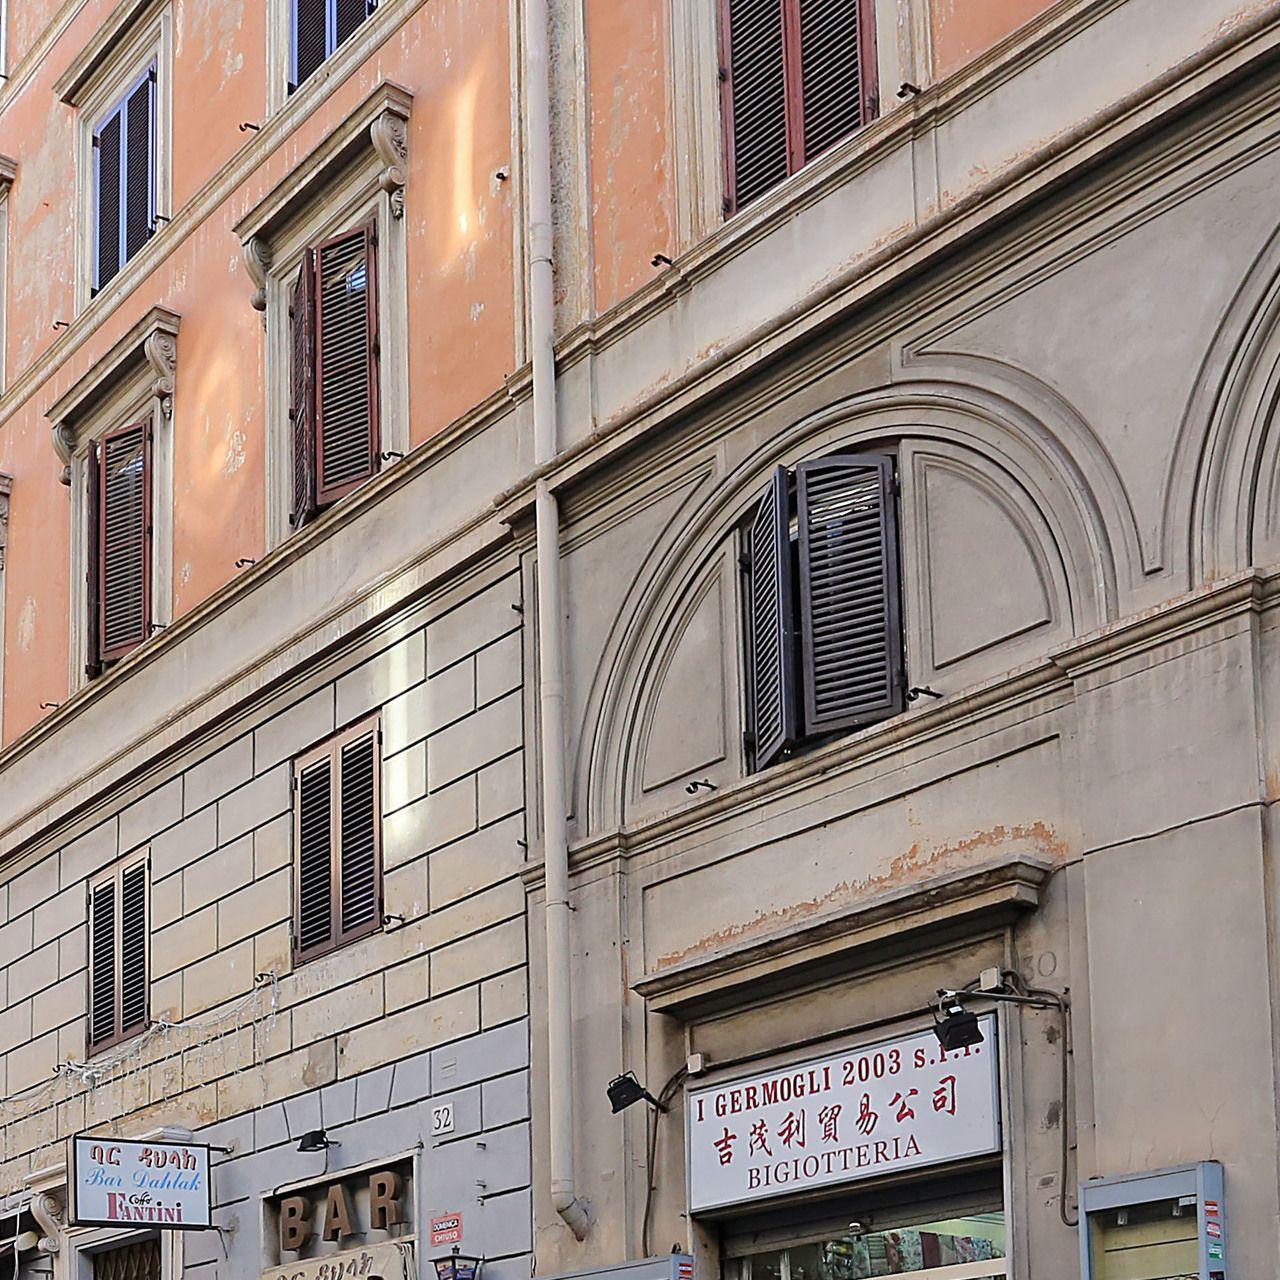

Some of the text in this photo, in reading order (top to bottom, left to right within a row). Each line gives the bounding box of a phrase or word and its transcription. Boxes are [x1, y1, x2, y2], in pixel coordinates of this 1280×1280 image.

[696, 1098, 705, 1122] I
[715, 1066, 831, 1118] GERMOGLI
[842, 1049, 901, 1087] 2003
[433, 1107, 451, 1130] 32
[84, 1167, 201, 1191] Bar Dahlak
[747, 1133, 923, 1190] BIGIOTTERIA
[281, 1171, 405, 1251] BAR
[434, 1231, 458, 1242] CHIUSO
